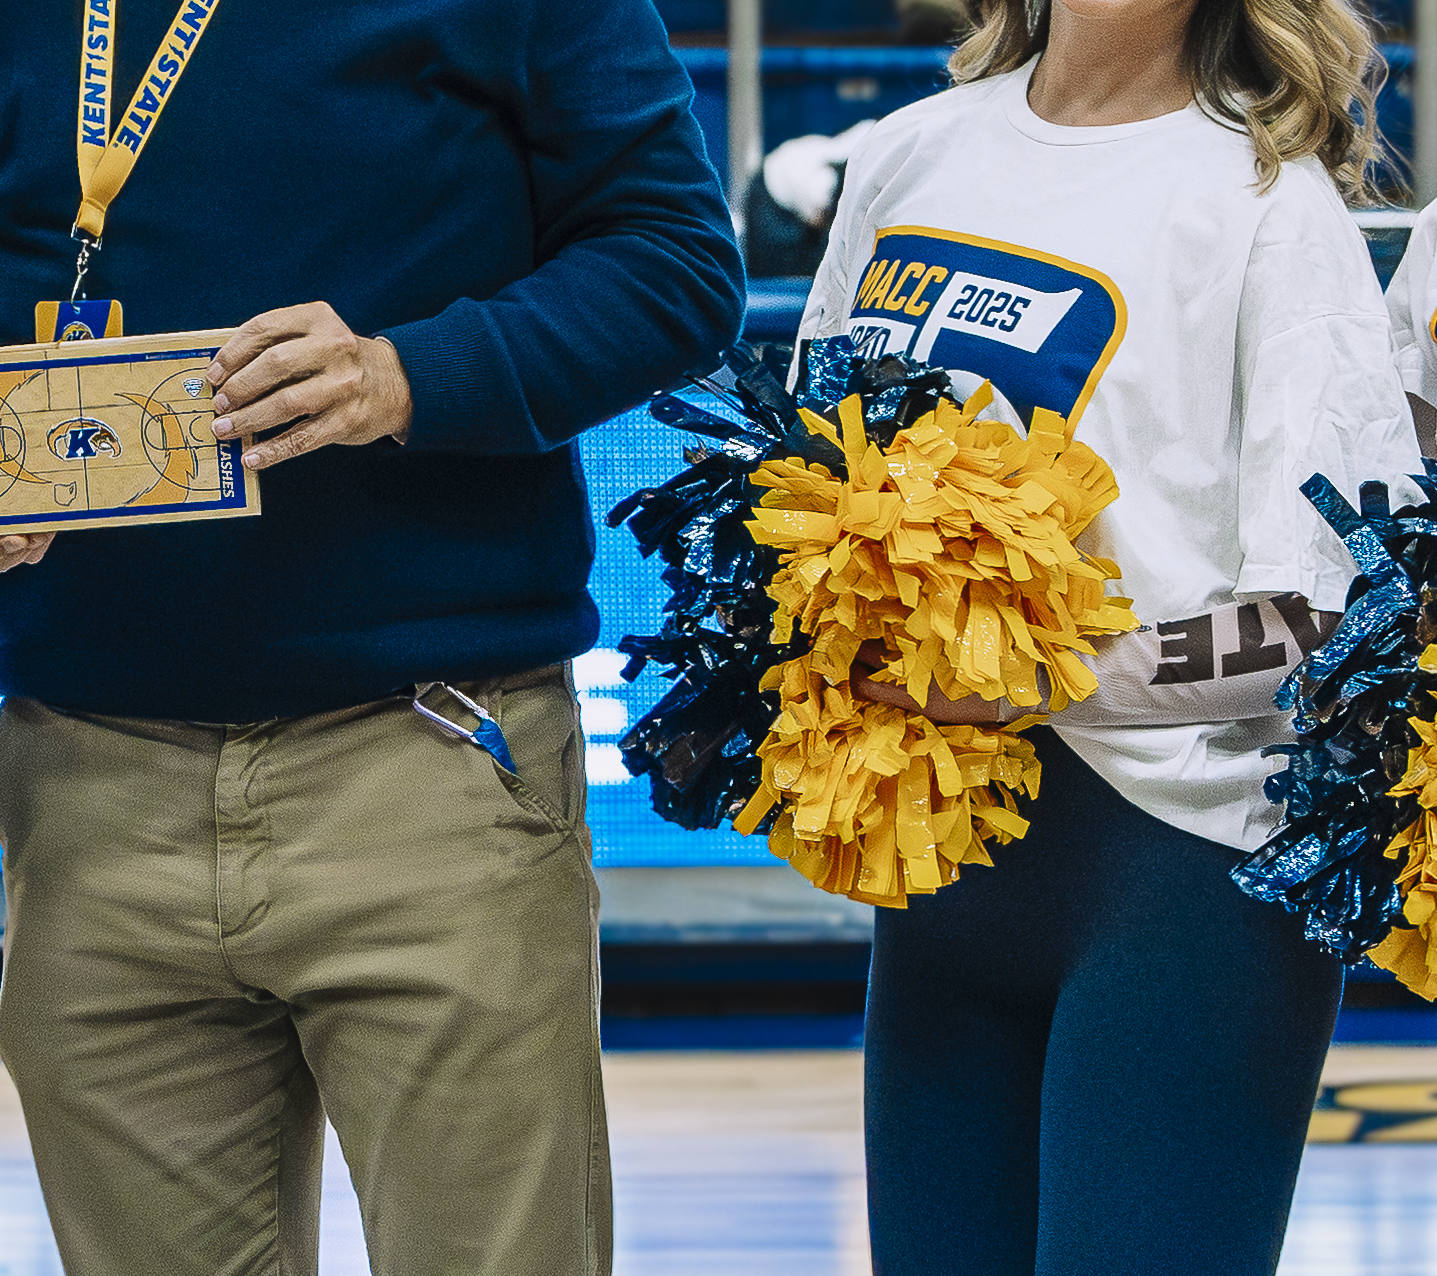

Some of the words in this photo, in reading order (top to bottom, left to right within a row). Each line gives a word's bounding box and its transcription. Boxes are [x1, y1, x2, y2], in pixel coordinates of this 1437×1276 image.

[81, 63, 106, 148] KENT
[118, 53, 180, 155] STATE
[851, 259, 949, 317] MACC
[946, 284, 1032, 333] 2025
[220, 443, 235, 498] LASHES
